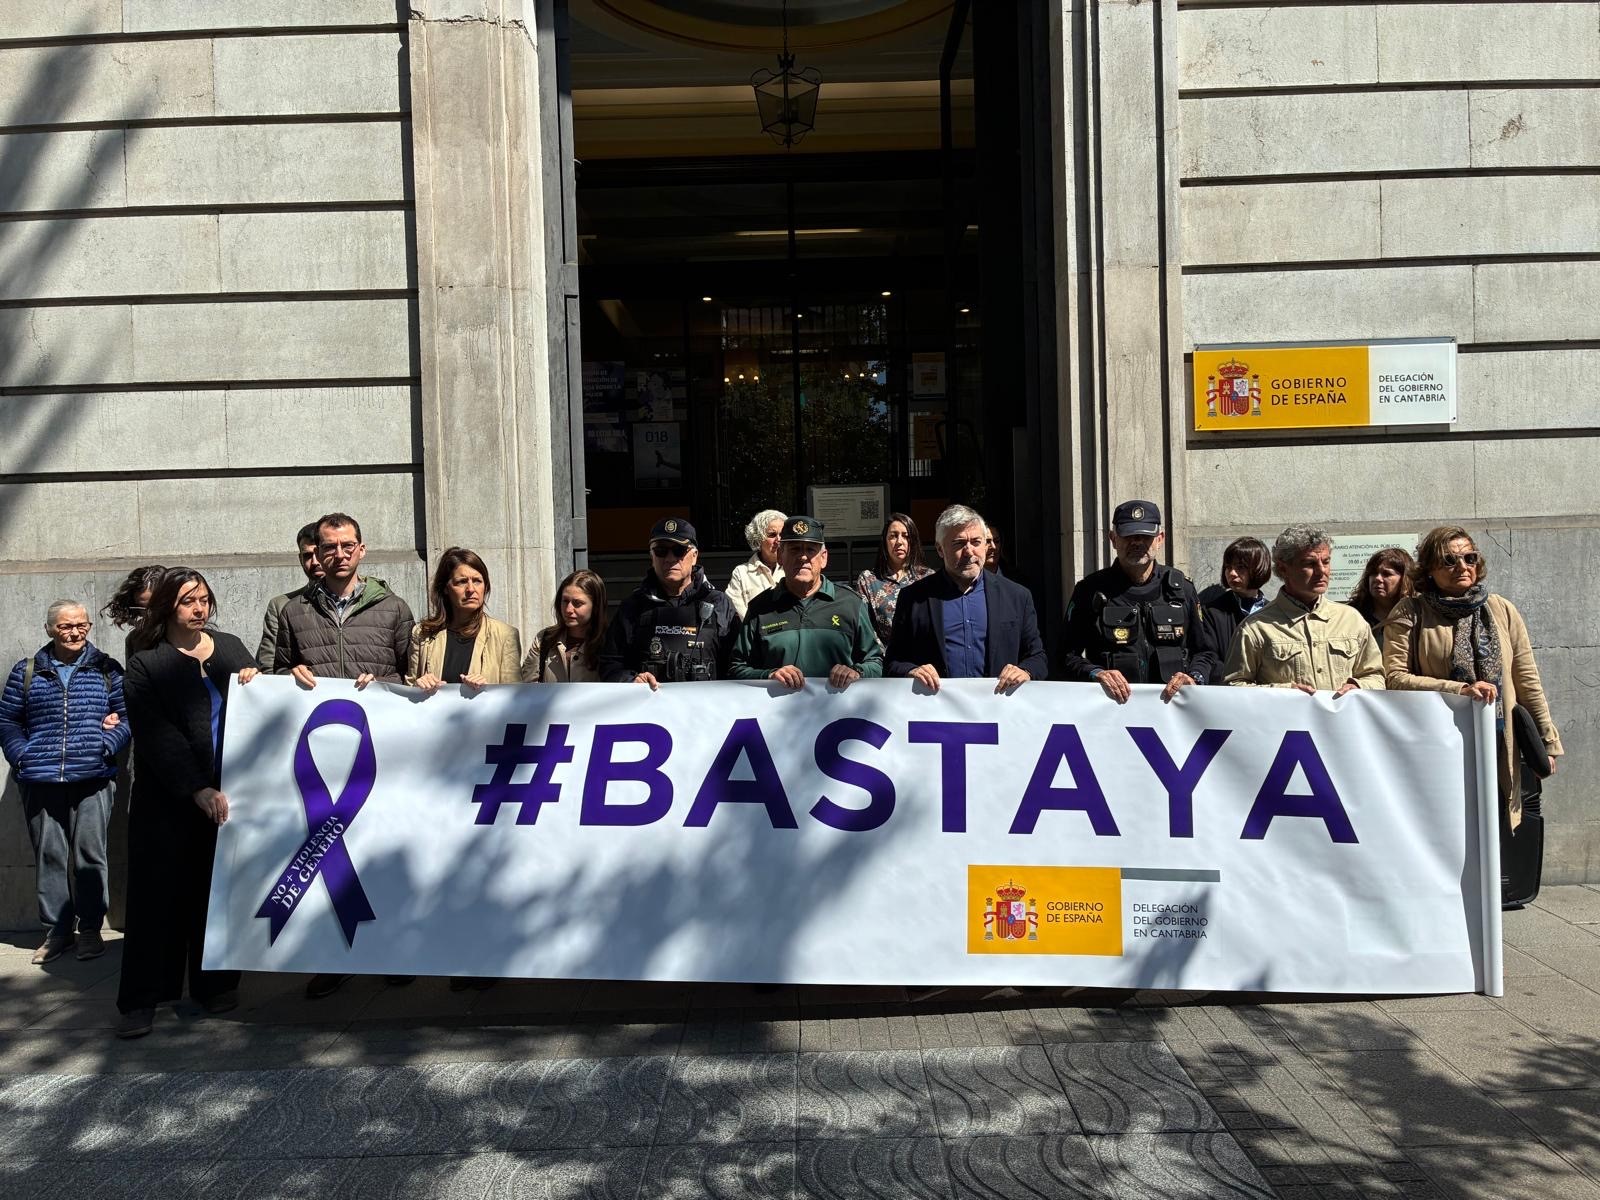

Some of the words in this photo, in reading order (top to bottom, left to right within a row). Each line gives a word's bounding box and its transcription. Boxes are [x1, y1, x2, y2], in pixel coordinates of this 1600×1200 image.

[1271, 377, 1347, 390] GOBIERNO
[1378, 372, 1434, 383] DELEGACIÓN
[1379, 384, 1395, 393] DEL
[1398, 383, 1443, 392] GOBIERNO
[1271, 394, 1289, 406] DE
[1294, 390, 1347, 405] ESPAÑA
[1379, 395, 1390, 403] EN
[1393, 393, 1446, 403] CANTABRIA
[471, 718, 1359, 844] #BASTAYA
[271, 884, 287, 905] NO
[286, 874, 293, 883] +
[291, 816, 339, 872] VIOLENCIA
[281, 883, 302, 910] DE
[299, 823, 344, 883] GENERO
[1046, 901, 1104, 912] GOBIERNO
[1133, 902, 1198, 914] DELEGACIÓN
[1046, 914, 1061, 923] DE
[1063, 911, 1104, 924] ESPAÑA
[1133, 916, 1152, 925] DEL
[1154, 916, 1208, 927] GOBIERNO
[1133, 928, 1149, 938] EN
[1150, 929, 1207, 939] CANTABRIA
